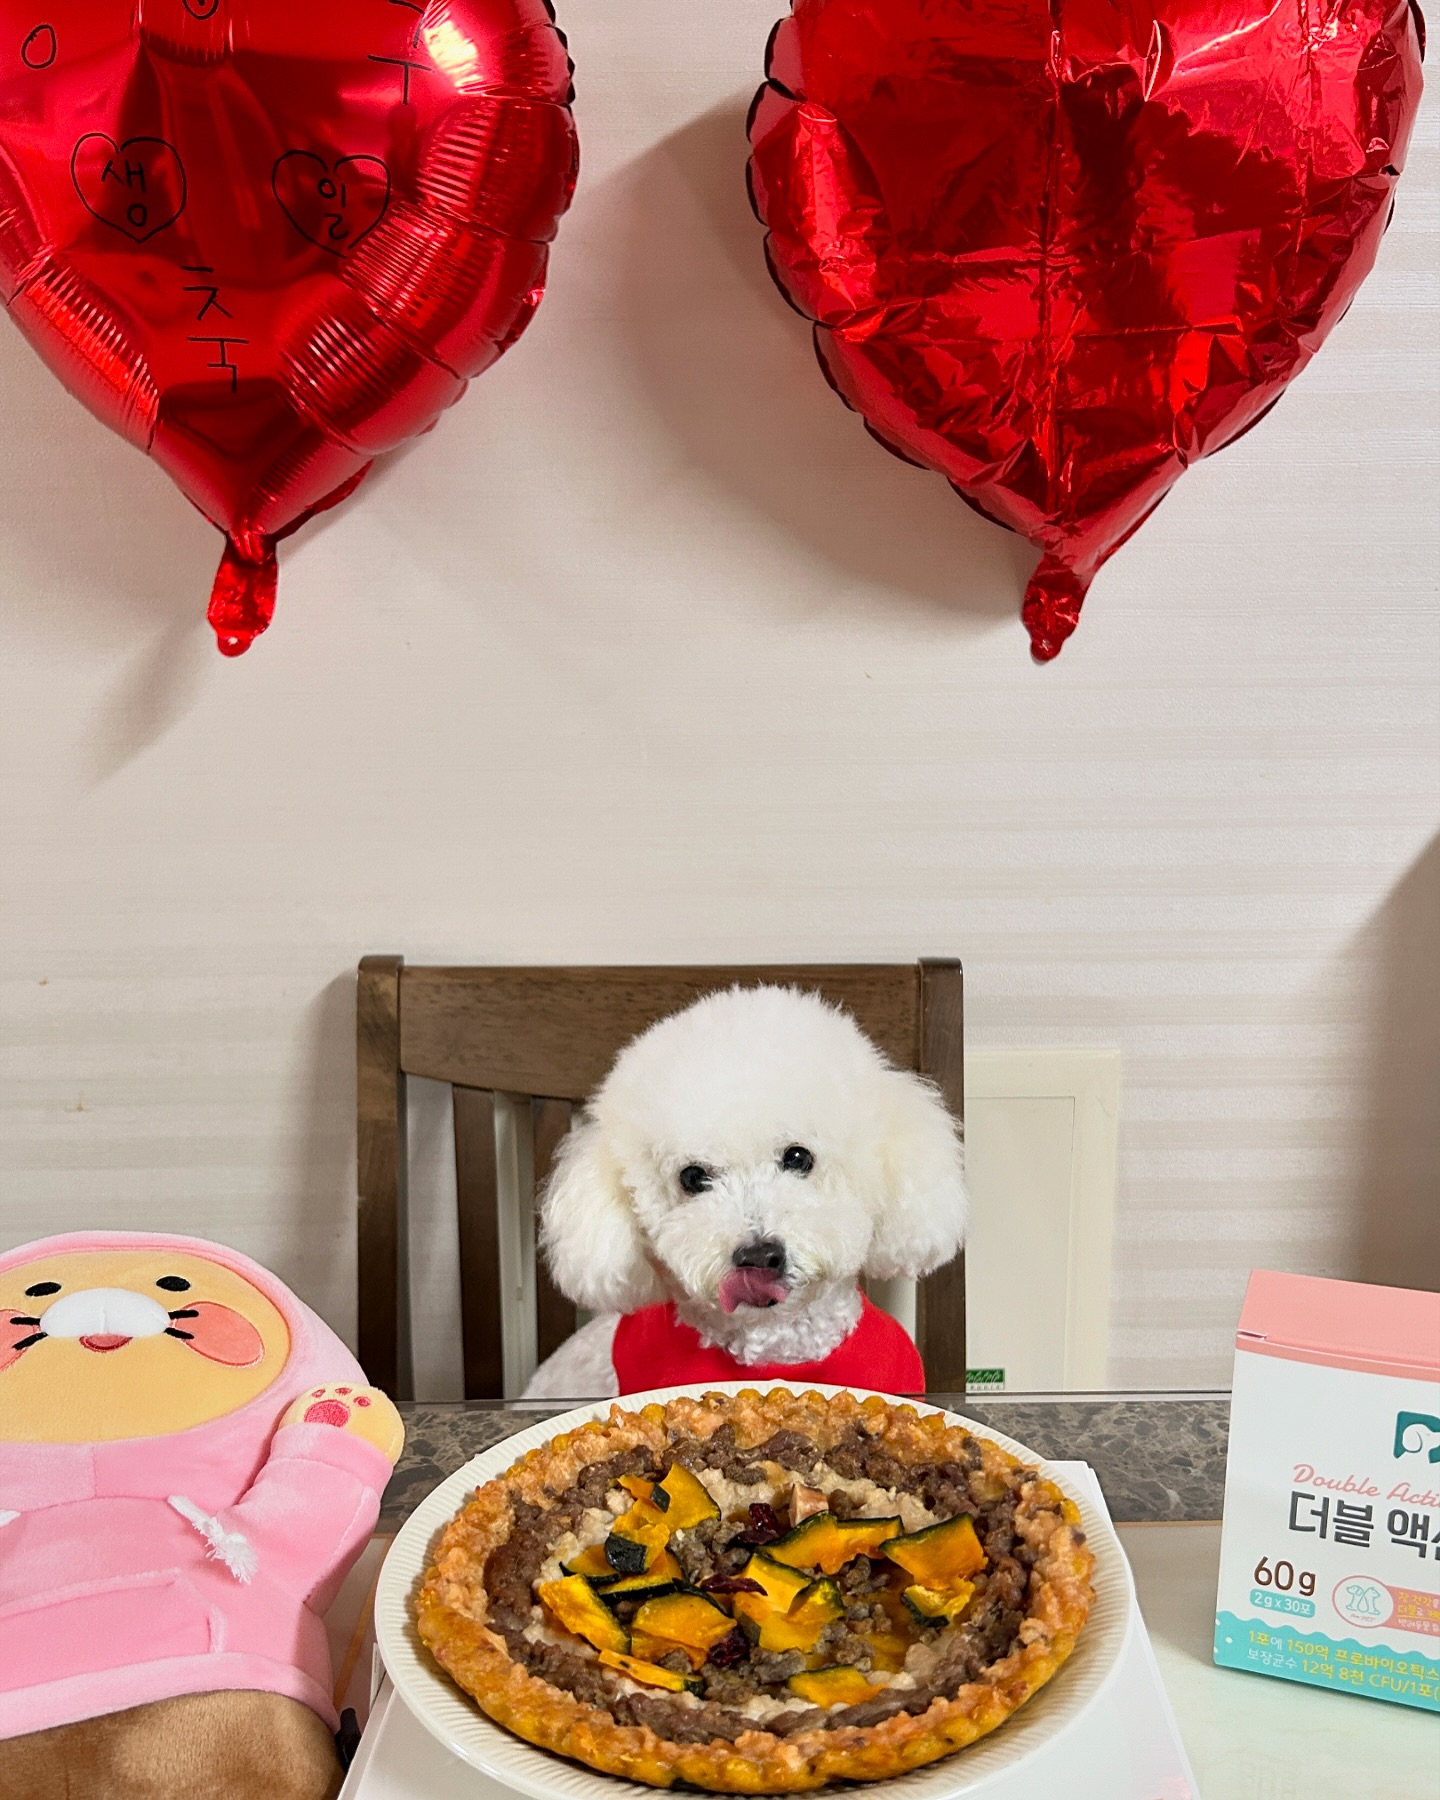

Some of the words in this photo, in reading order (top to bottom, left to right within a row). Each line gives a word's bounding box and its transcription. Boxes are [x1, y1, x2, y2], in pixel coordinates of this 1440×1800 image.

[100, 160, 147, 228] 생
[317, 177, 350, 240] 일
[180, 265, 250, 394] 축
[1293, 1463, 1381, 1497] Double
[1386, 1481, 1440, 1508] Acti
[1288, 1490, 1375, 1549] 더블
[1253, 1555, 1317, 1597] 60g
[1248, 1648, 1297, 1669] 보장균수
[1302, 1659, 1334, 1680] 12억
[1339, 1667, 1364, 1685] 8천
[1249, 1630, 1283, 1651] 1포에
[1287, 1639, 1329, 1661] 150억
[1335, 1649, 1440, 1681] 프로바이오틱스
